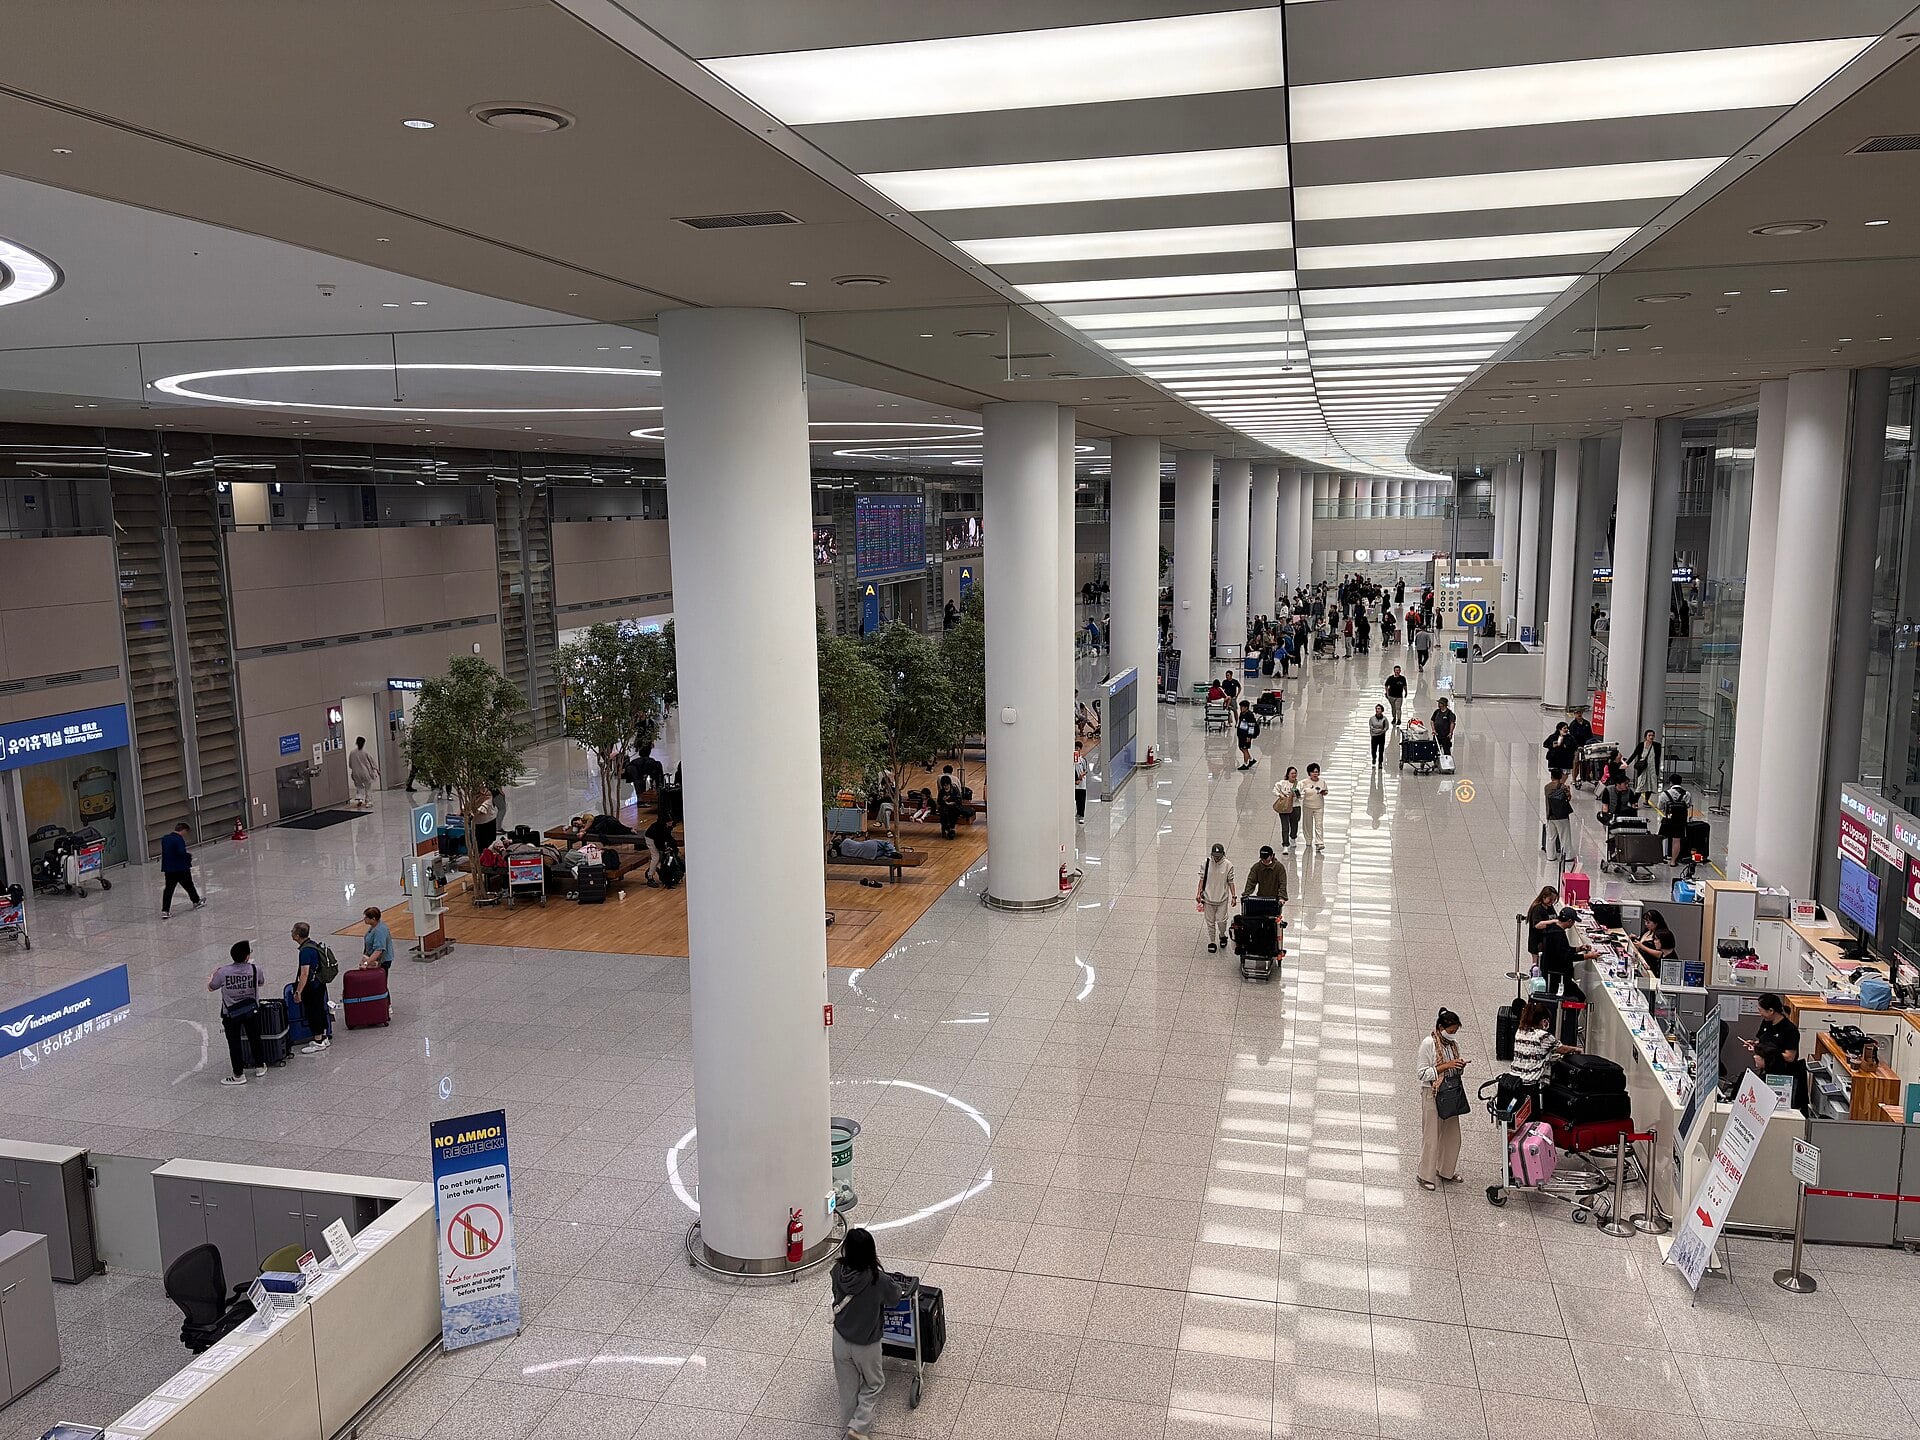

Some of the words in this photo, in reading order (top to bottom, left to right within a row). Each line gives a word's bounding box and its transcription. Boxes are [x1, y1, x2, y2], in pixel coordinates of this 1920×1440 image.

[962, 569, 970, 578] A
[866, 584, 876, 596] A
[8, 730, 62, 754] 유아휴게실
[65, 736, 86, 745] Nursing
[87, 731, 103, 740] Room
[1842, 820, 1849, 831] 5G
[1849, 824, 1868, 845] Upgrade
[30, 1010, 61, 1030] Incheon
[63, 998, 91, 1016] Airport
[1739, 1093, 1749, 1108] SK
[1748, 1105, 1765, 1126] telecom
[435, 1136, 454, 1148] NO
[457, 1126, 501, 1144] AMMO!
[443, 1138, 504, 1159] RECHECK!
[1714, 1147, 1742, 1184] SK로밍센터
[484, 1173, 505, 1182] Ammo
[476, 1183, 502, 1193] Airport.
[445, 1277, 462, 1285] Check
[472, 1271, 490, 1279] Ammo
[499, 1265, 511, 1274] your
[453, 1282, 470, 1292] person
[483, 1273, 505, 1285] luggage
[458, 1288, 475, 1297] before
[477, 1282, 501, 1293] traveling
[472, 1322, 491, 1332] Incheon
[492, 1318, 510, 1326] Airport
